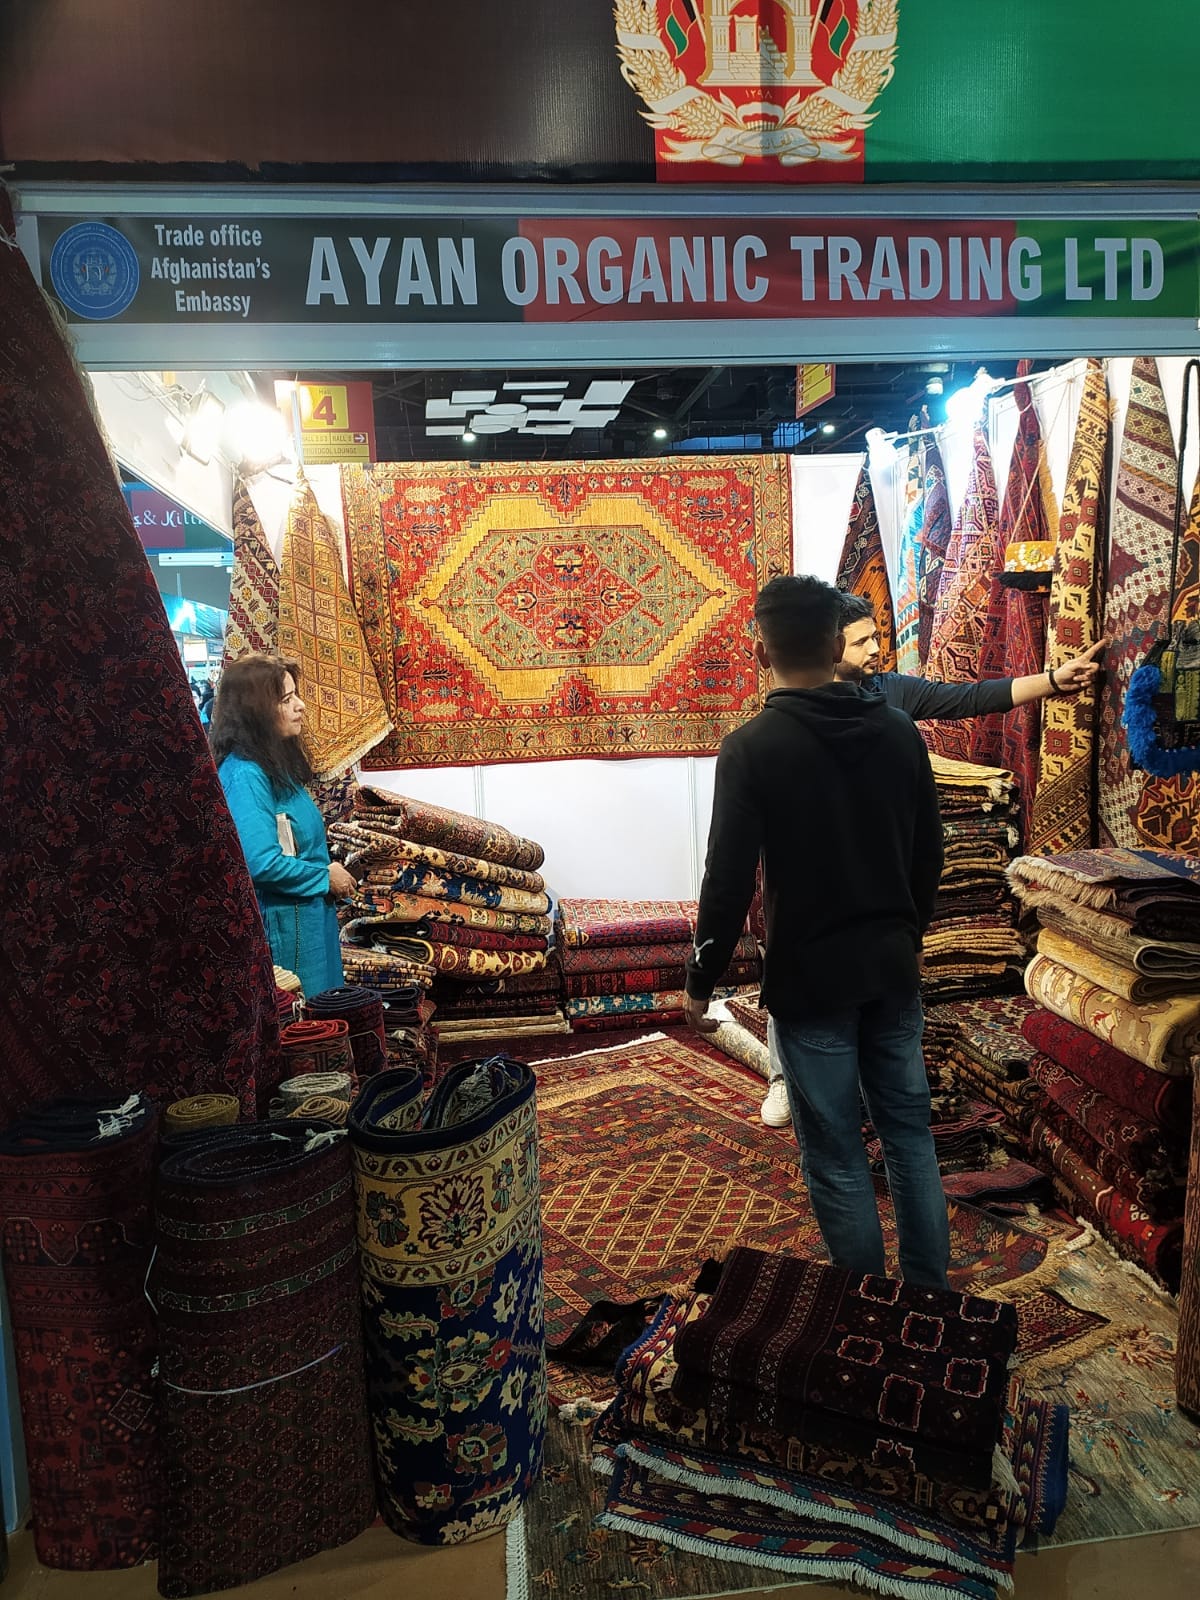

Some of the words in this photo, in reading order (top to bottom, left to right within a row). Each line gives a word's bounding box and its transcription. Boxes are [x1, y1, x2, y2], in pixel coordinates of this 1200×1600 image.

[154, 225, 205, 246] Trade
[210, 225, 262, 246] office
[151, 256, 271, 284] Afghanistan's
[305, 237, 478, 306] AYAN
[500, 235, 770, 306] ORGANIC
[790, 235, 1043, 302] TRADING
[1064, 237, 1165, 302] LTD
[175, 290, 251, 318] Embassy
[313, 396, 336, 425] 4
